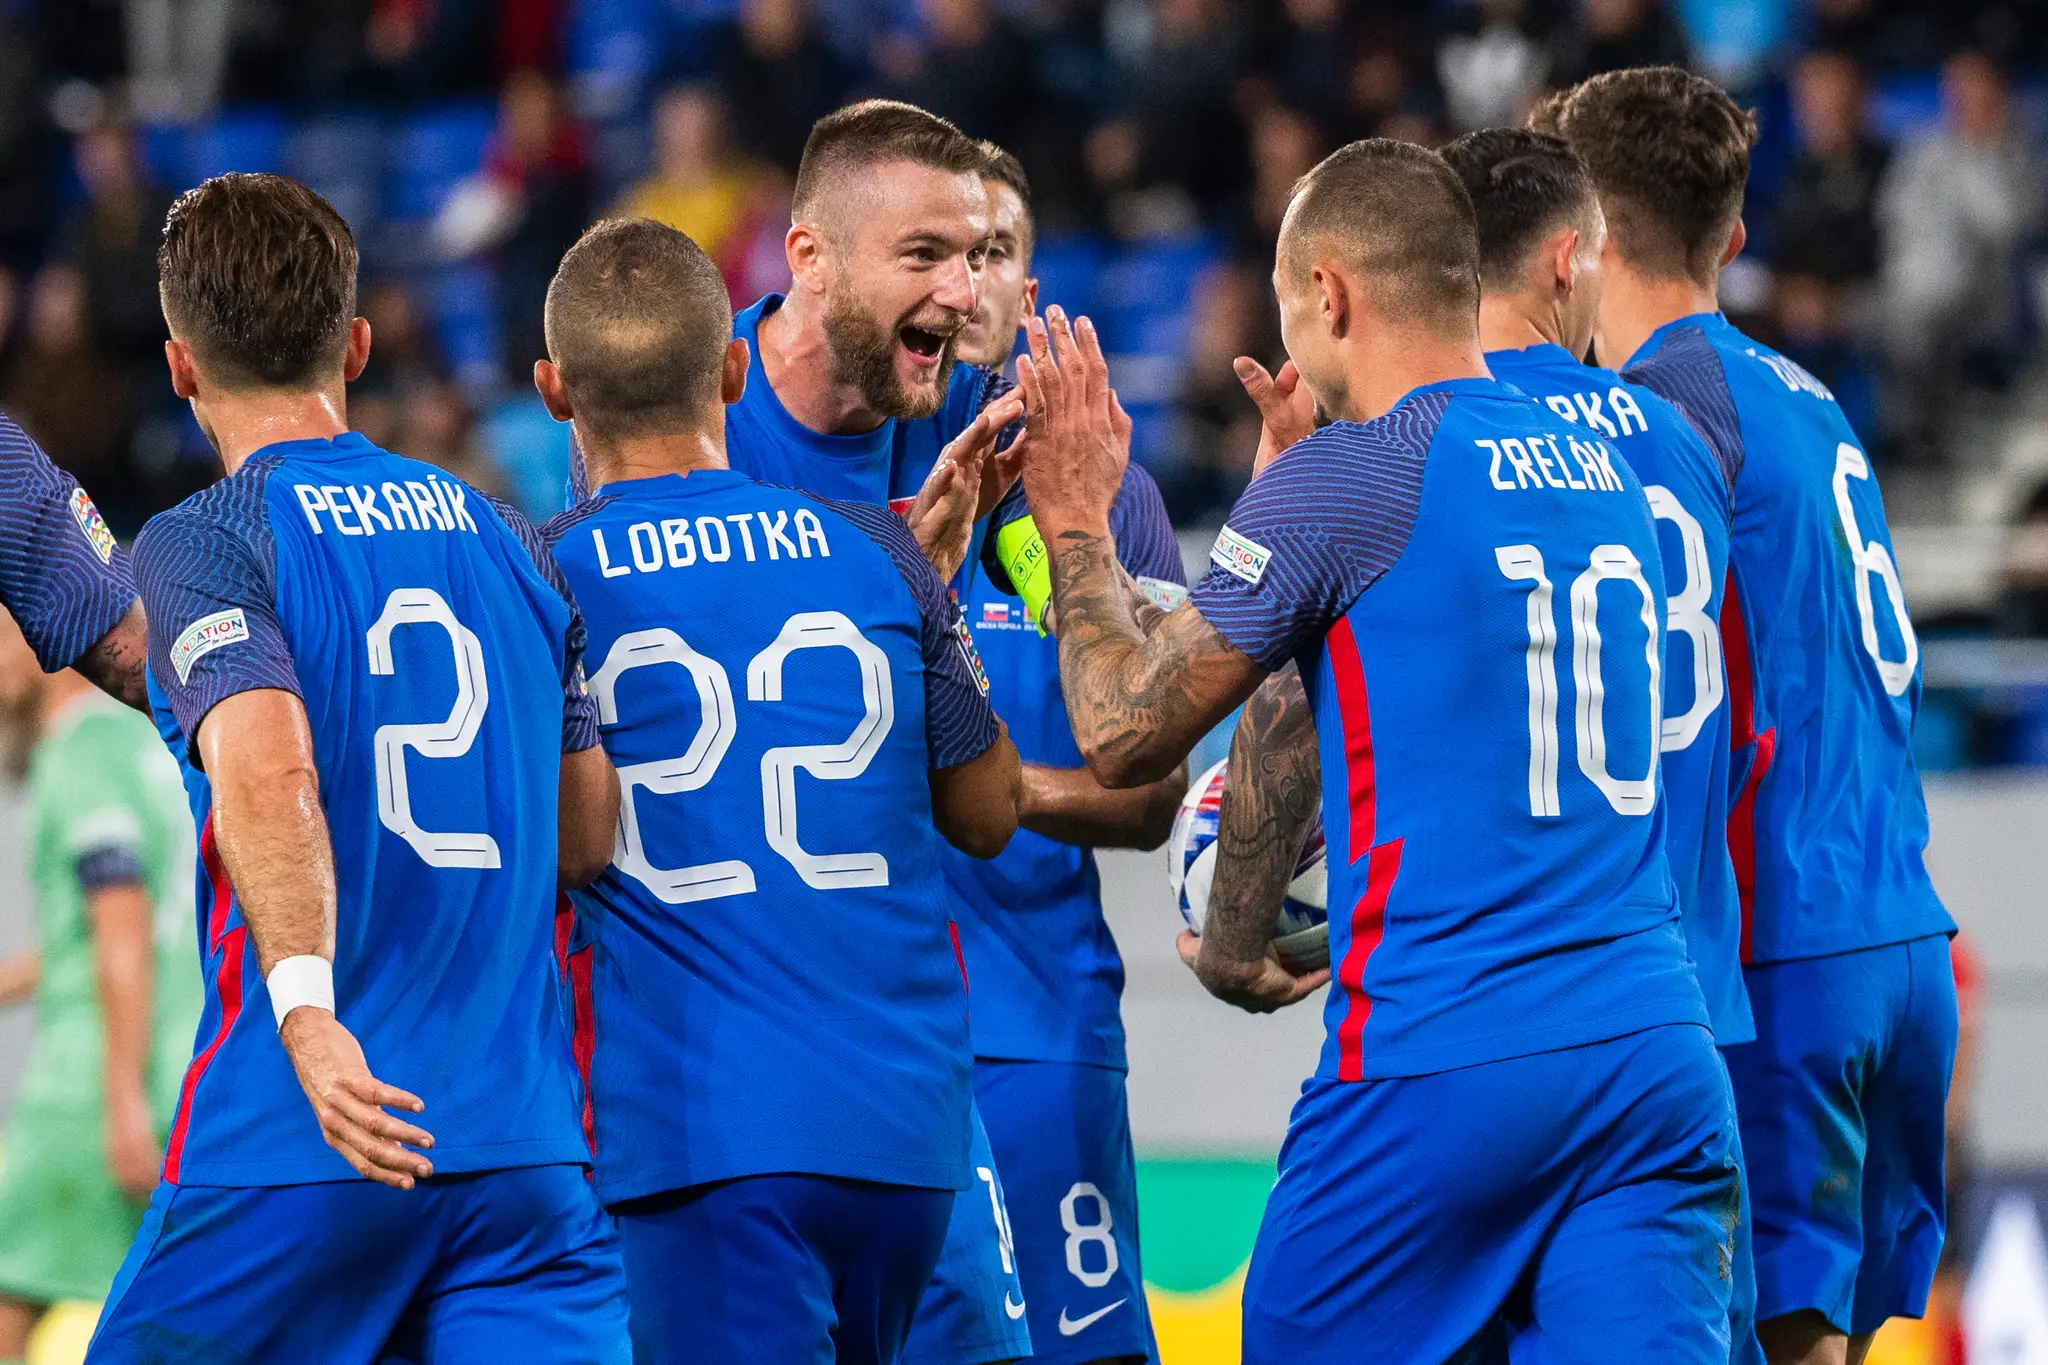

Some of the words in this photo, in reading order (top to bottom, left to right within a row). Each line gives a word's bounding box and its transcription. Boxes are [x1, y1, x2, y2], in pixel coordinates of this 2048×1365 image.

[1532, 386, 1649, 438] RKA
[293, 474, 479, 536] PEKARÍK
[591, 508, 831, 579] LOBOTKA
[1024, 539, 1044, 564] RE
[1832, 442, 1919, 697] 6
[366, 587, 502, 869] 2
[1494, 544, 1662, 817] 10
[586, 610, 895, 905] 22
[1059, 1182, 1119, 1288] 8
